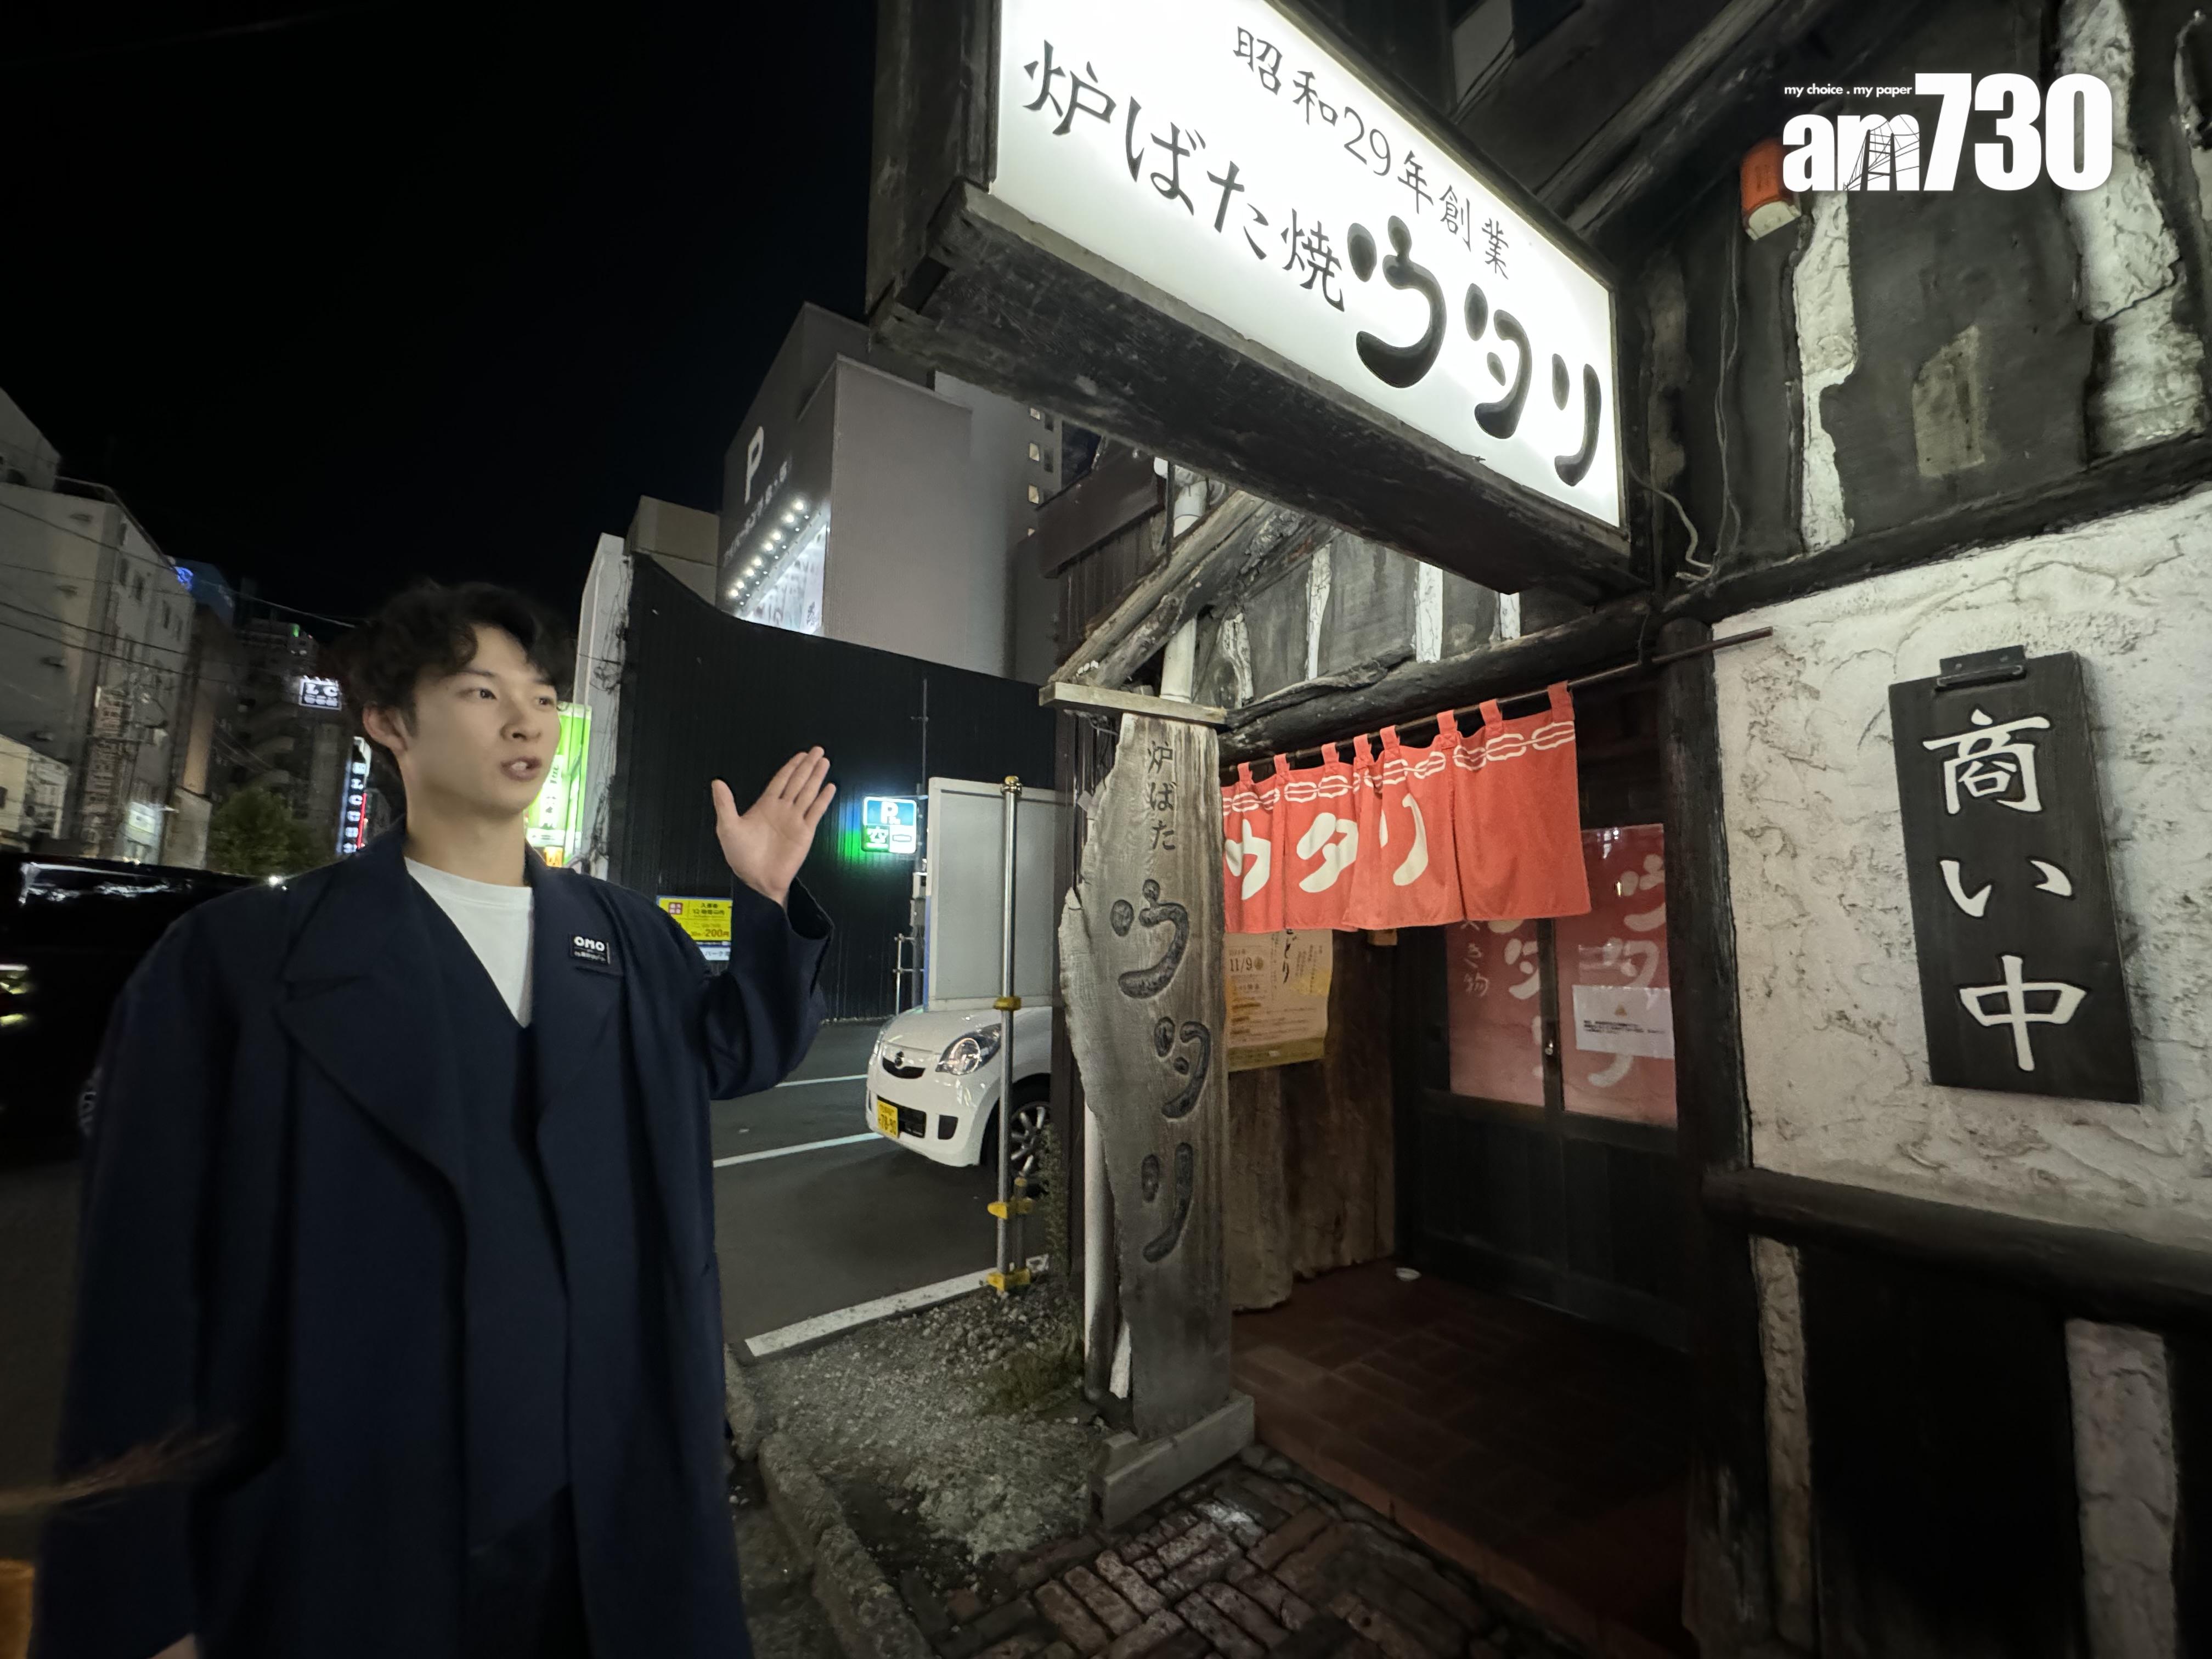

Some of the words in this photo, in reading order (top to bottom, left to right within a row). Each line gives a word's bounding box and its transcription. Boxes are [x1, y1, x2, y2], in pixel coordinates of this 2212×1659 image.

[1233, 25, 1510, 281] 昭和29年創業
[1147, 740, 1177, 851] 炉ばた
[1922, 708, 2088, 1072] 商い中
[574, 936, 605, 952] OMO
[1109, 878, 1211, 1263] ウタリ
